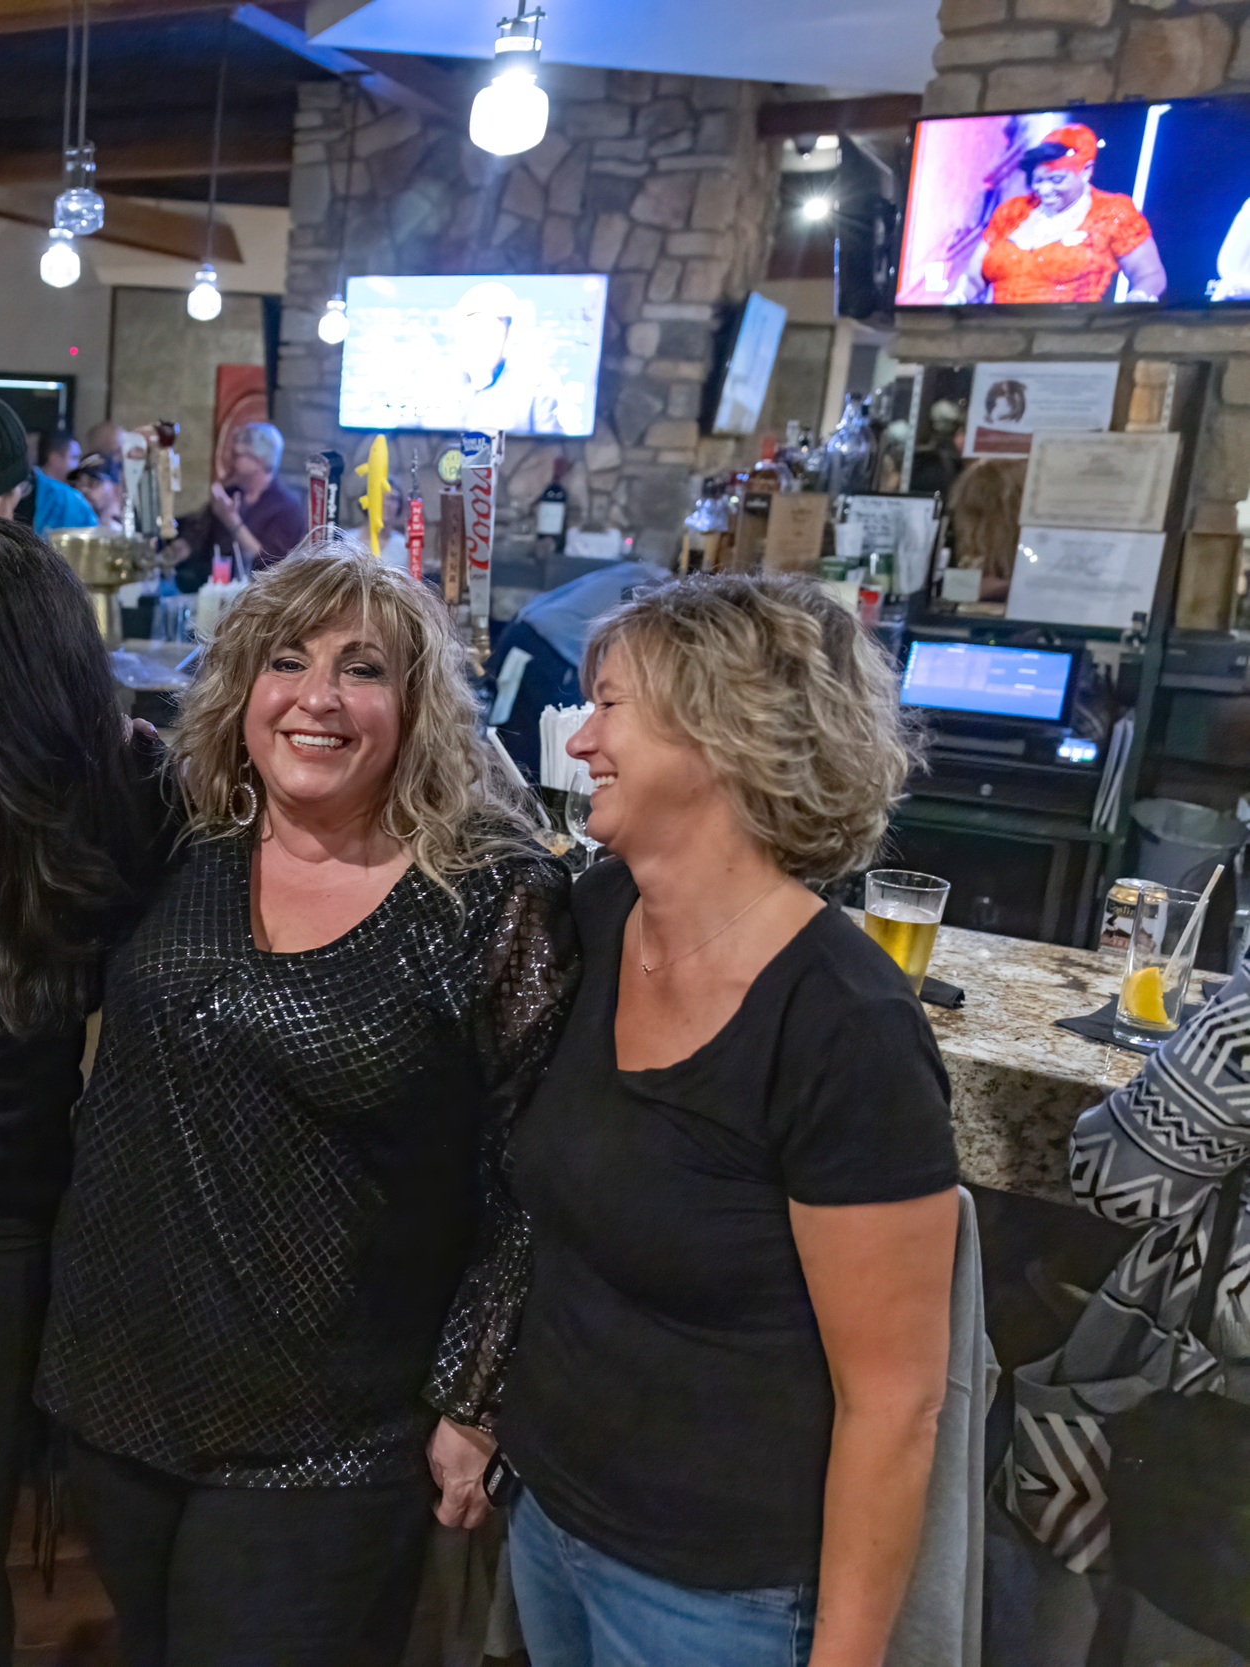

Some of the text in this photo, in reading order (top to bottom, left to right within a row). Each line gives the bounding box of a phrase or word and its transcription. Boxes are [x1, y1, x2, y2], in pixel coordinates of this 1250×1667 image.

[411, 507, 421, 579] NEW BELGI
[466, 467, 492, 570] Coors
